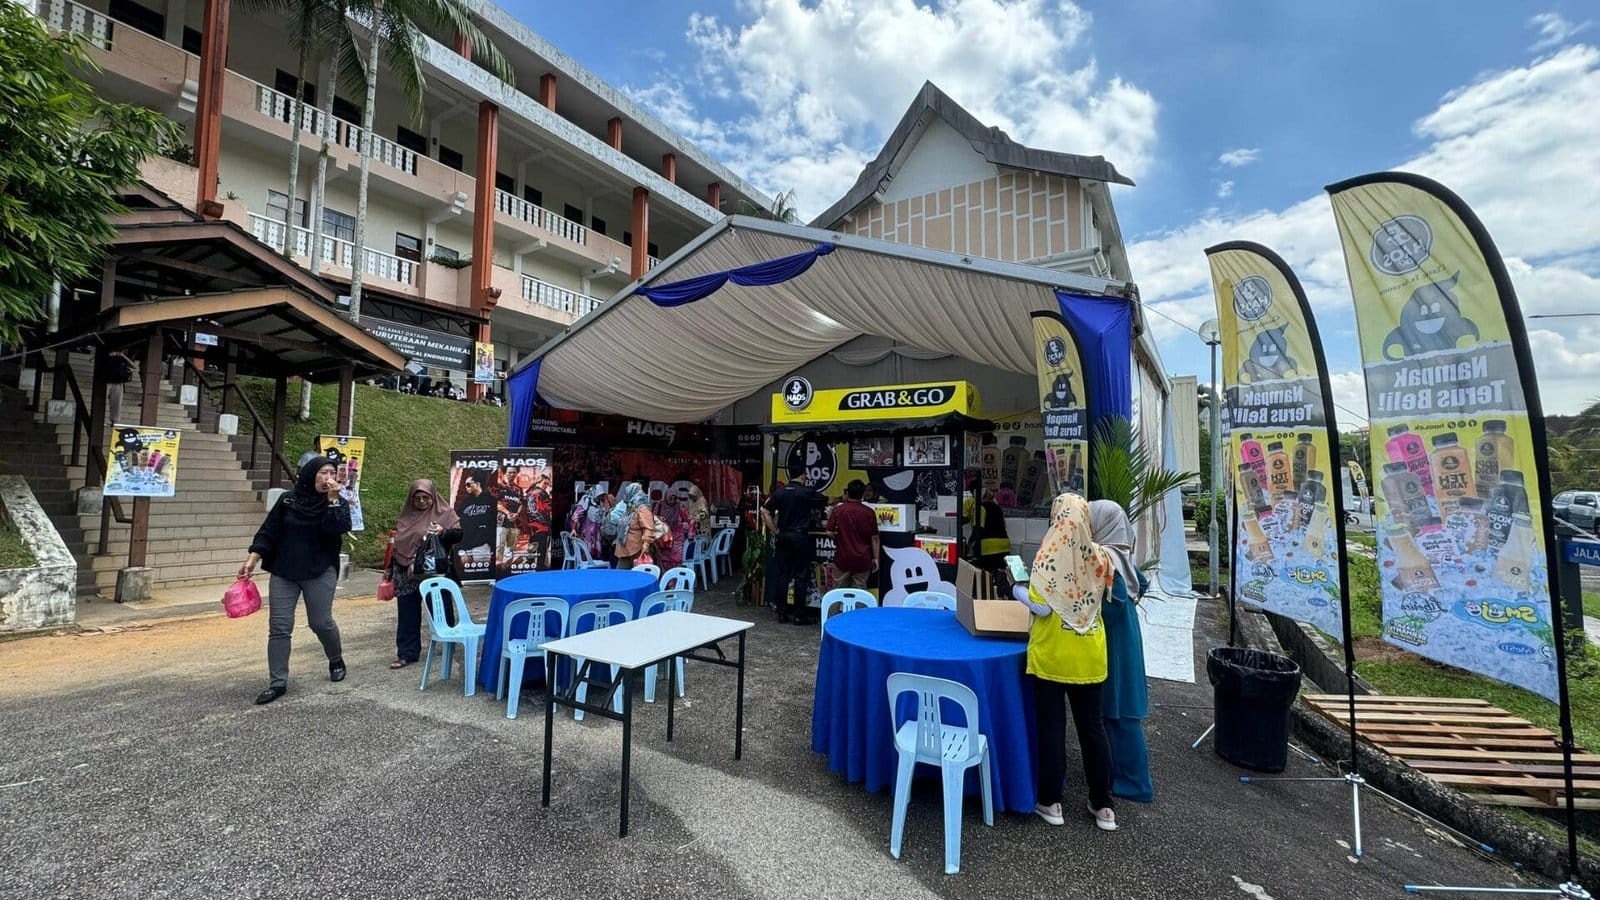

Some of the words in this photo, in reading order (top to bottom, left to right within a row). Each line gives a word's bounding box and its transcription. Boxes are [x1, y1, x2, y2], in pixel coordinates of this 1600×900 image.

[377, 325, 405, 335] SELAMAT
[405, 331, 430, 340] DATANG
[426, 341, 471, 356] MEKANIKAL
[423, 352, 463, 364] ENGINEERING
[786, 393, 806, 402] HAOS
[847, 388, 944, 409] GRAB&GO
[531, 418, 559, 427] NOTHING
[531, 425, 577, 435] UNPREDICTABLE
[627, 420, 676, 447] HAOS
[456, 460, 499, 474] HAOS
[502, 457, 548, 473] HAOS
